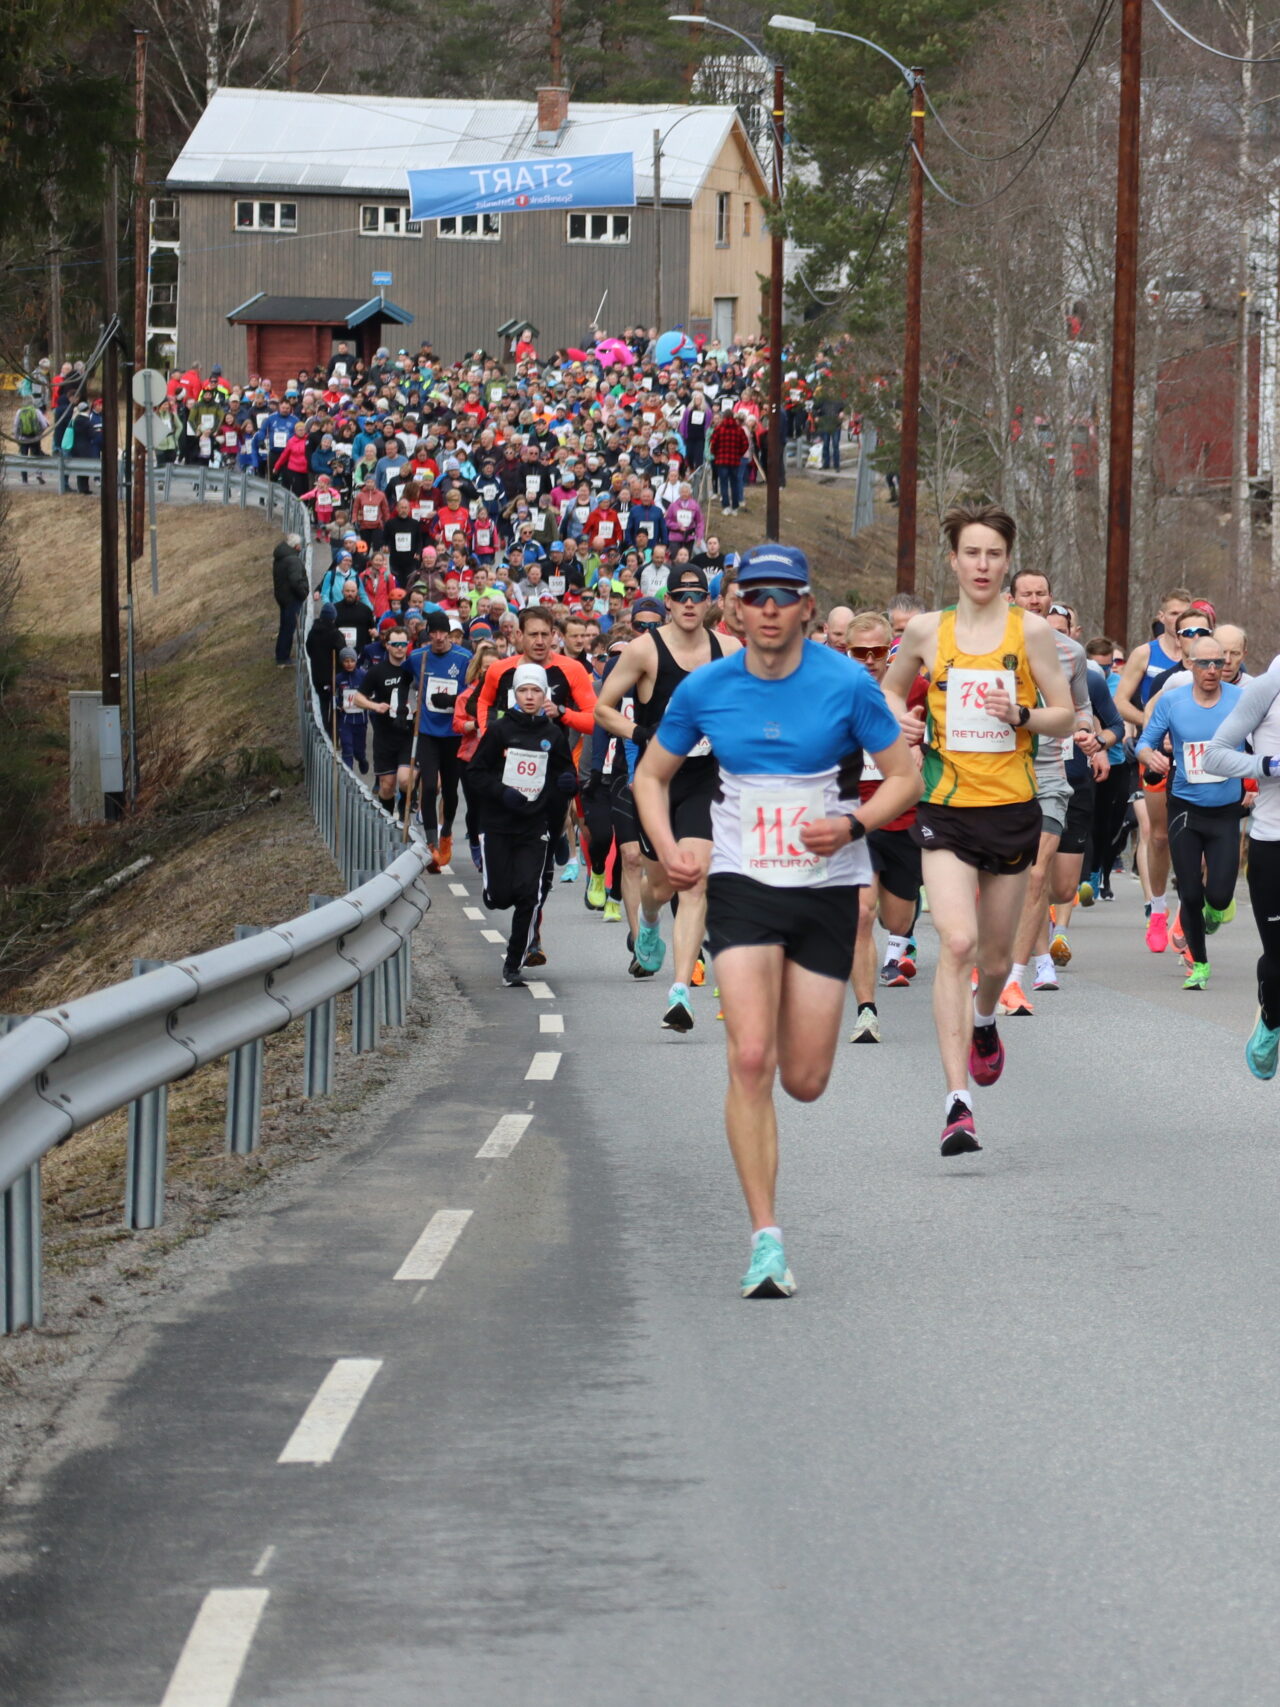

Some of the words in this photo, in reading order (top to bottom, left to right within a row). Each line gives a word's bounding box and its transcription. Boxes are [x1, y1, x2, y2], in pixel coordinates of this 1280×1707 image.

[961, 680, 989, 709] 78
[952, 729, 1004, 739] RETURA
[516, 760, 537, 776] 69
[751, 805, 812, 857] 113
[749, 857, 813, 869] RETURA
